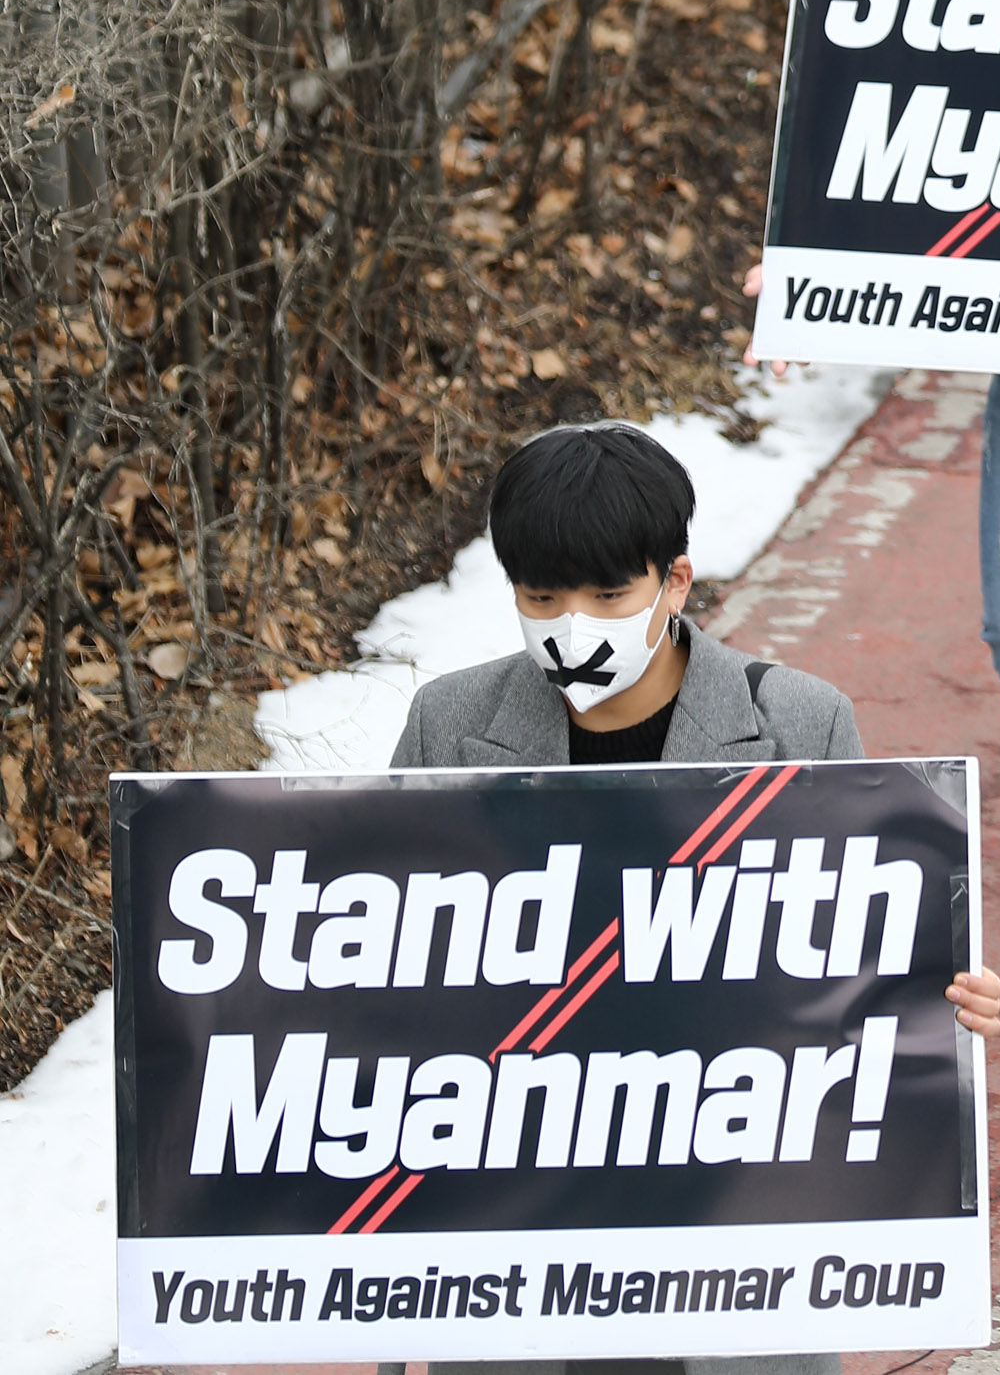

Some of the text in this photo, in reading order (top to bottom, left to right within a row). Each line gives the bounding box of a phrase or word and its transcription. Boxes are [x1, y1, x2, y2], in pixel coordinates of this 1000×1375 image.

[784, 276, 903, 327] Youth
[157, 835, 924, 995] Stand with
[189, 1015, 899, 1180] Myanmar!
[152, 1254, 946, 1325] Youth Against Myanmar Coup
